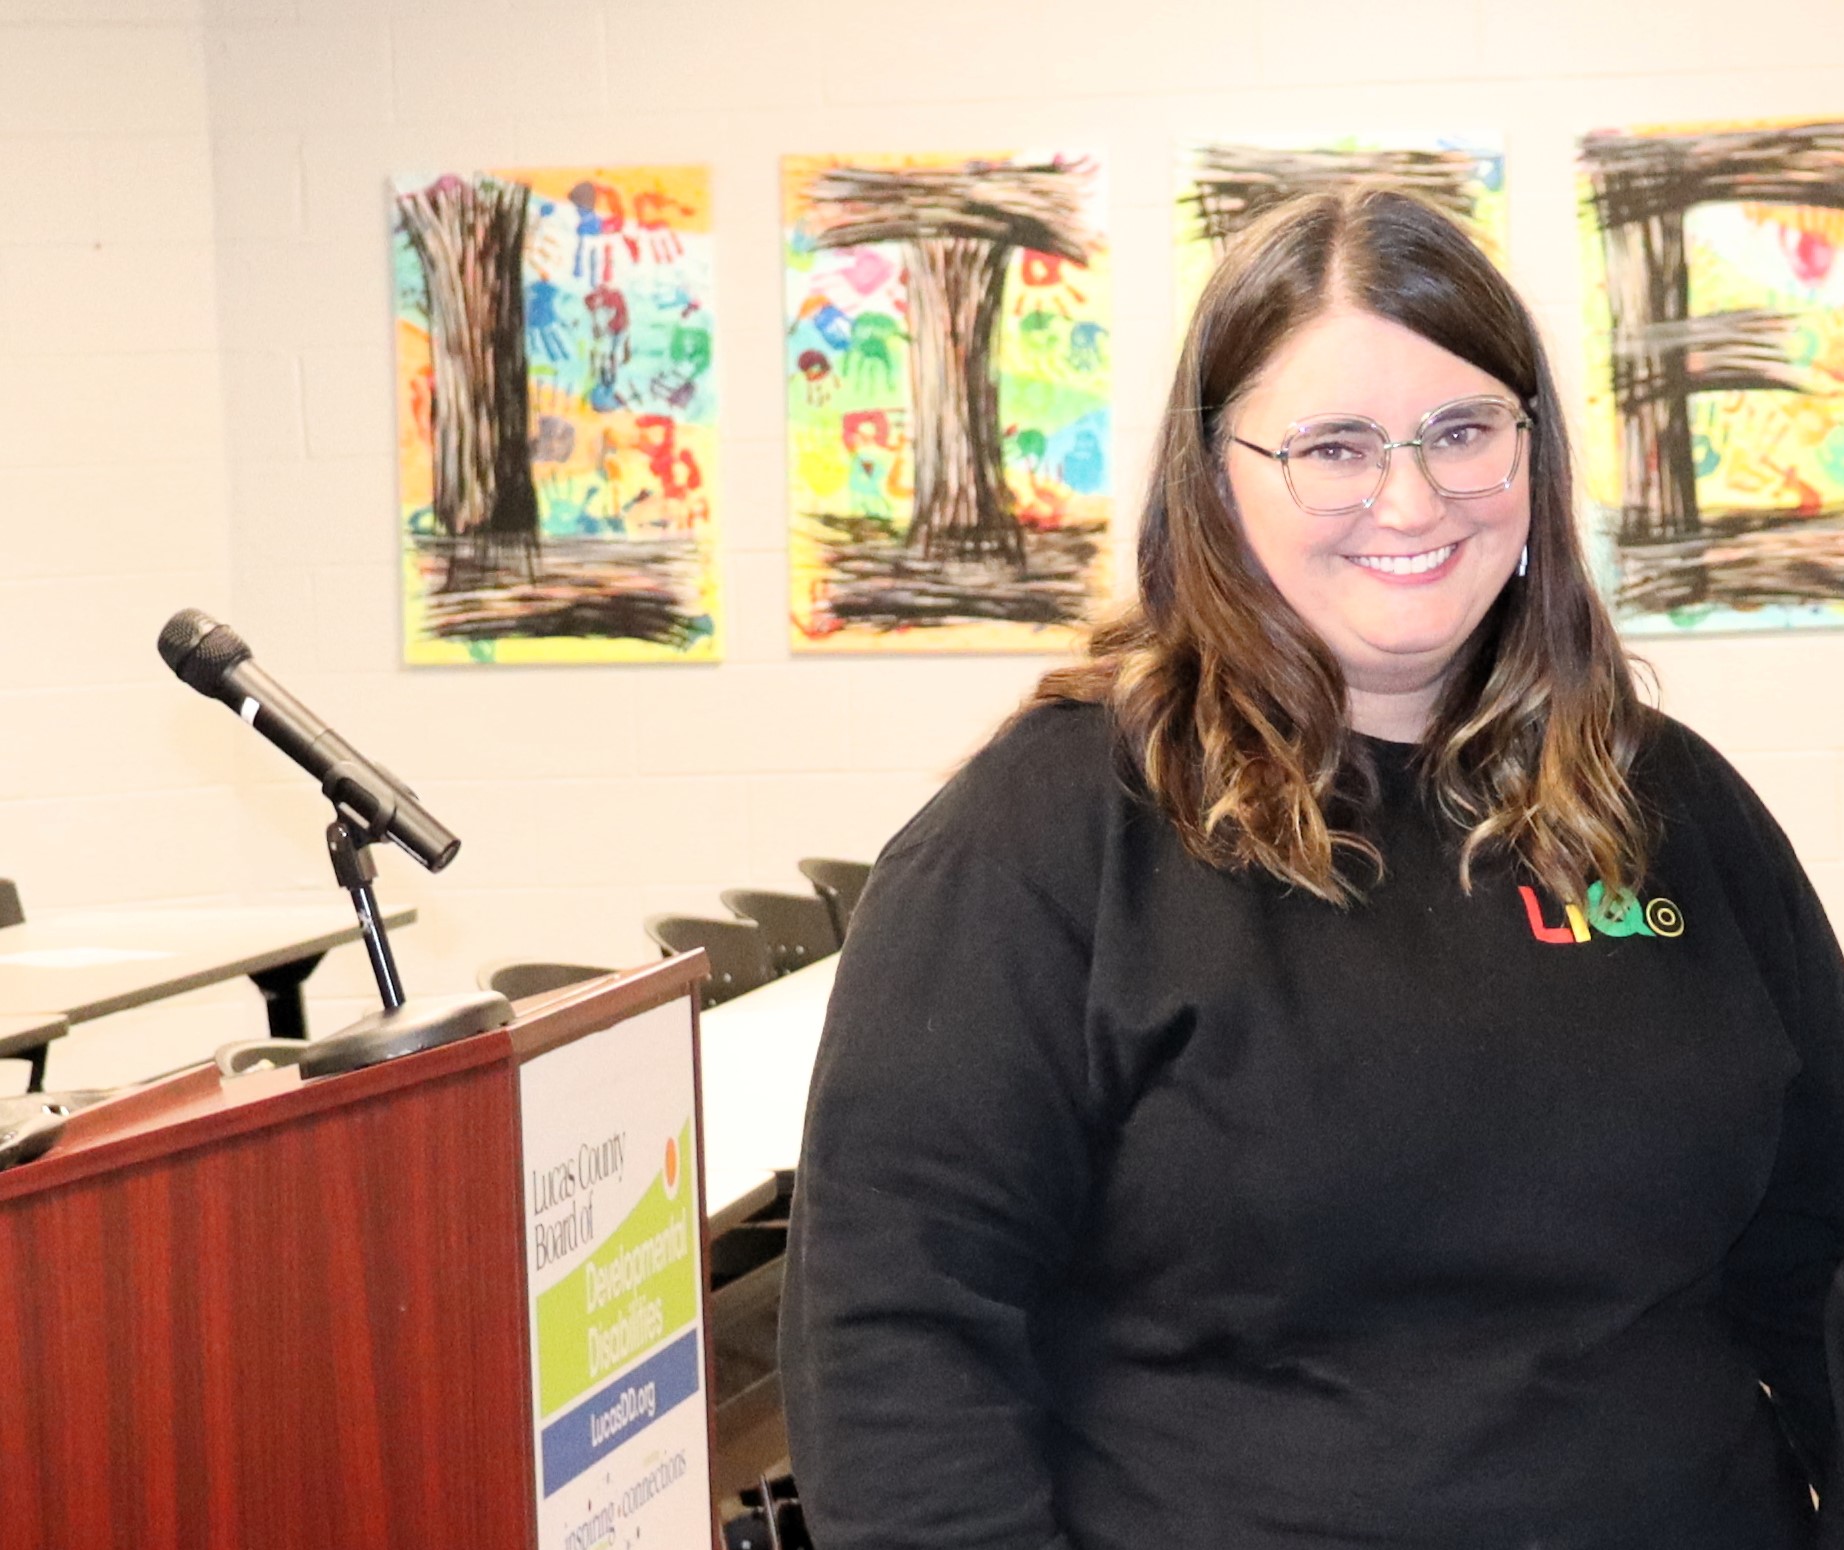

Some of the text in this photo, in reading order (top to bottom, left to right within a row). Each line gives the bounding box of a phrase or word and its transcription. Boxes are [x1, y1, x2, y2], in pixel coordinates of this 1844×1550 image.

[532, 1131, 626, 1216] Lucas County
[534, 1190, 595, 1272] Board of
[585, 1206, 689, 1315] Developmental
[587, 1293, 664, 1379] Disabilities
[590, 1380, 658, 1449] LucasDD.org
[621, 1449, 688, 1519] connections
